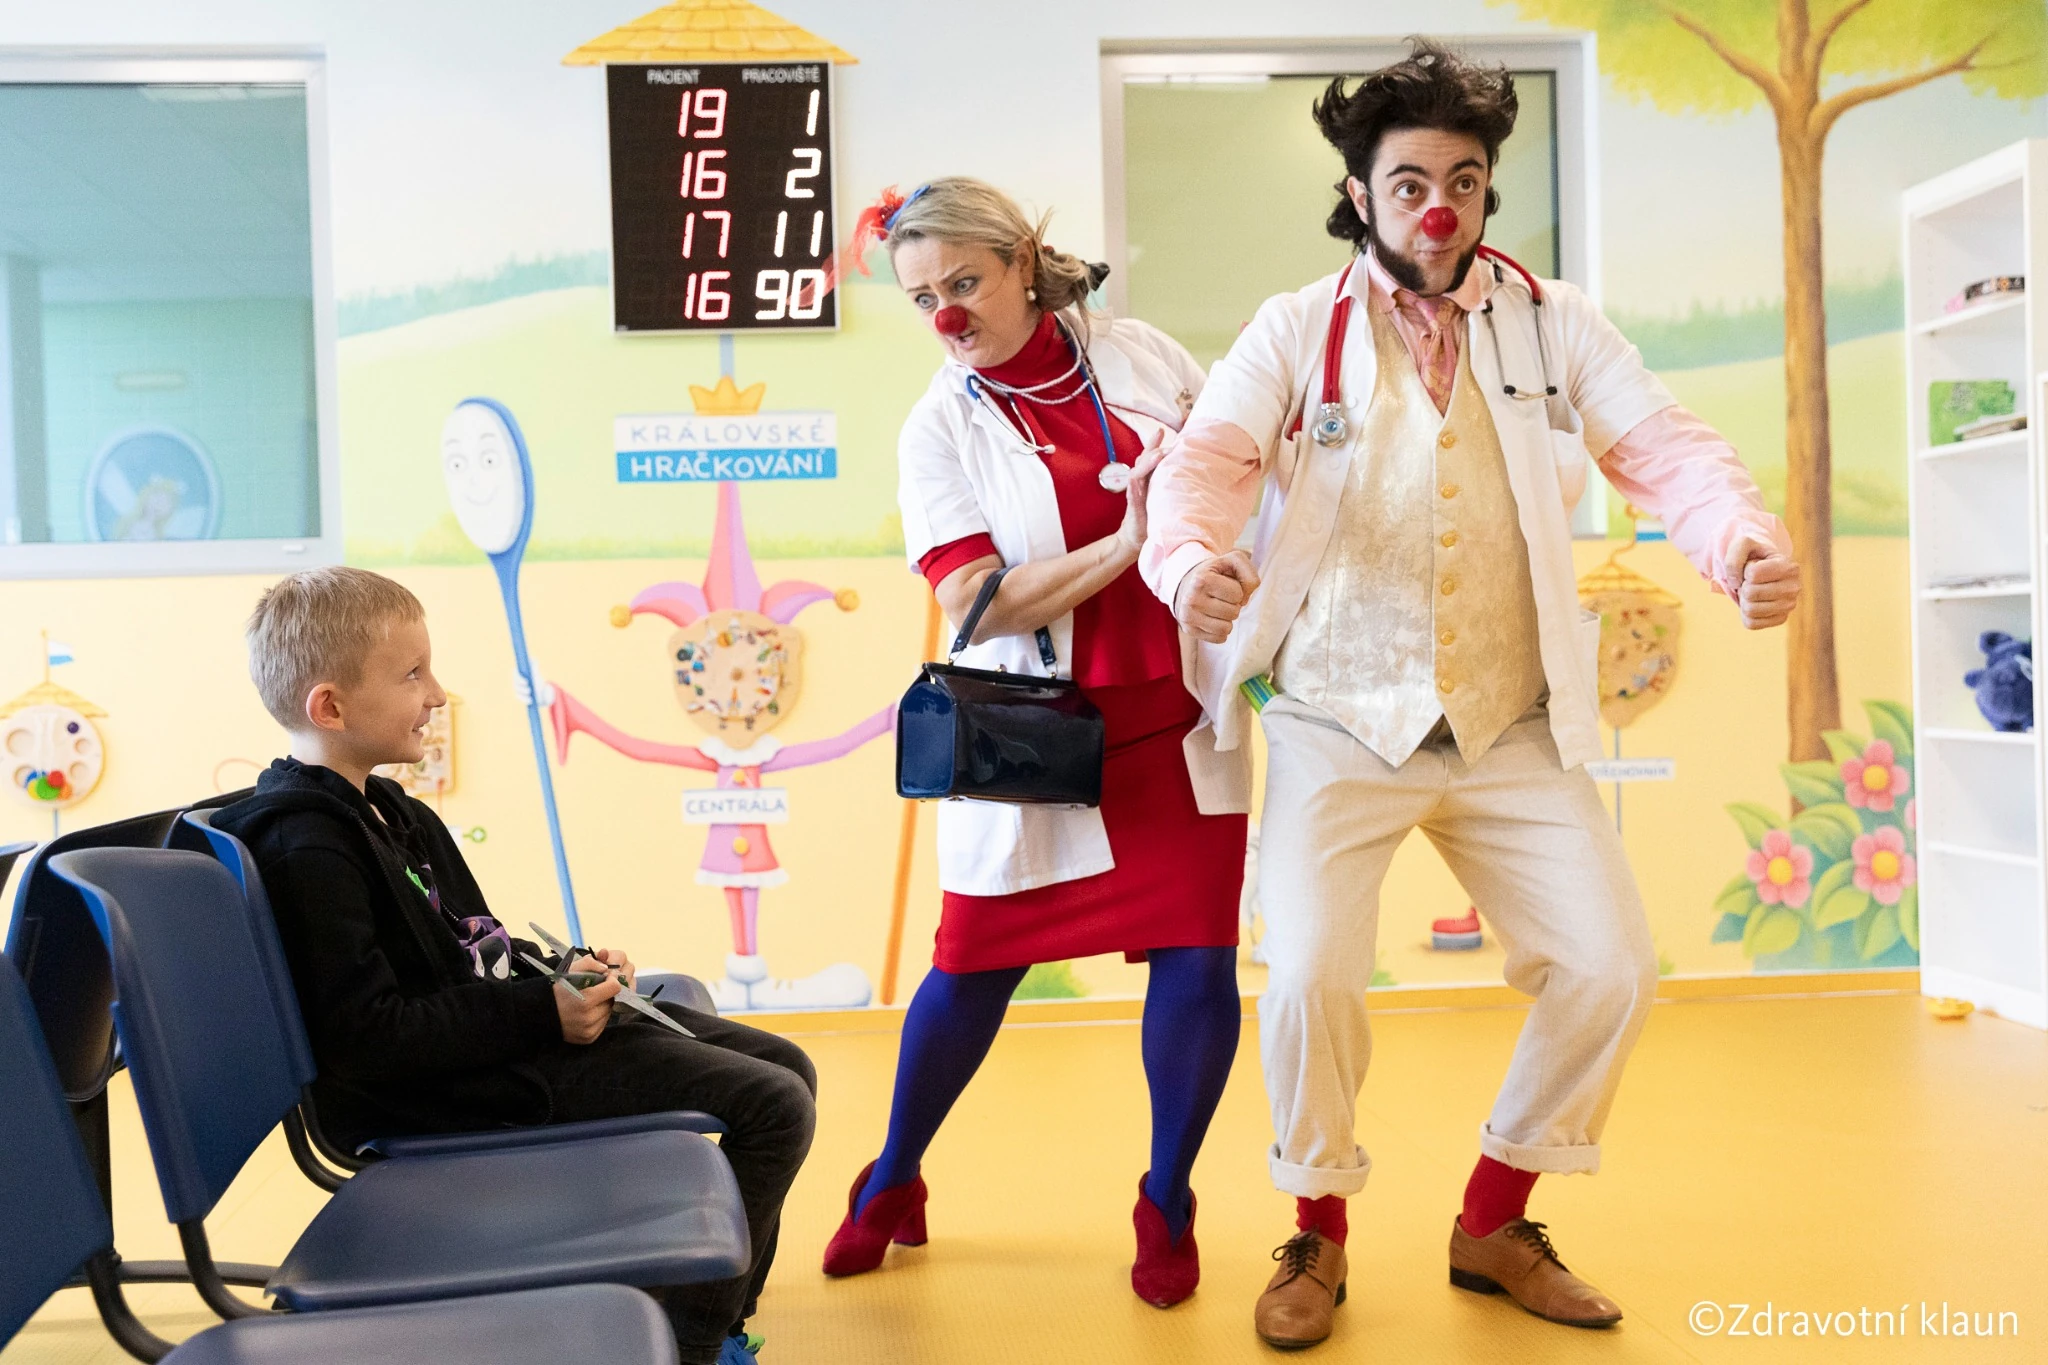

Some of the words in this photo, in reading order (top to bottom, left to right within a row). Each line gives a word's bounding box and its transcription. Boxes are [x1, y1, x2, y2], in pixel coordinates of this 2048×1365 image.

[647, 68, 701, 85] PACIENT
[678, 88, 727, 138] 19
[806, 89, 820, 136] 1
[680, 149, 727, 199] 16
[785, 148, 822, 198] 2
[682, 210, 731, 258] 17
[774, 210, 824, 258] 11
[684, 270, 731, 320] 16
[755, 268, 825, 320] 90
[631, 417, 826, 444] KRÁLOVSKÉ
[631, 449, 826, 479] HRAČKOVÁNÍ
